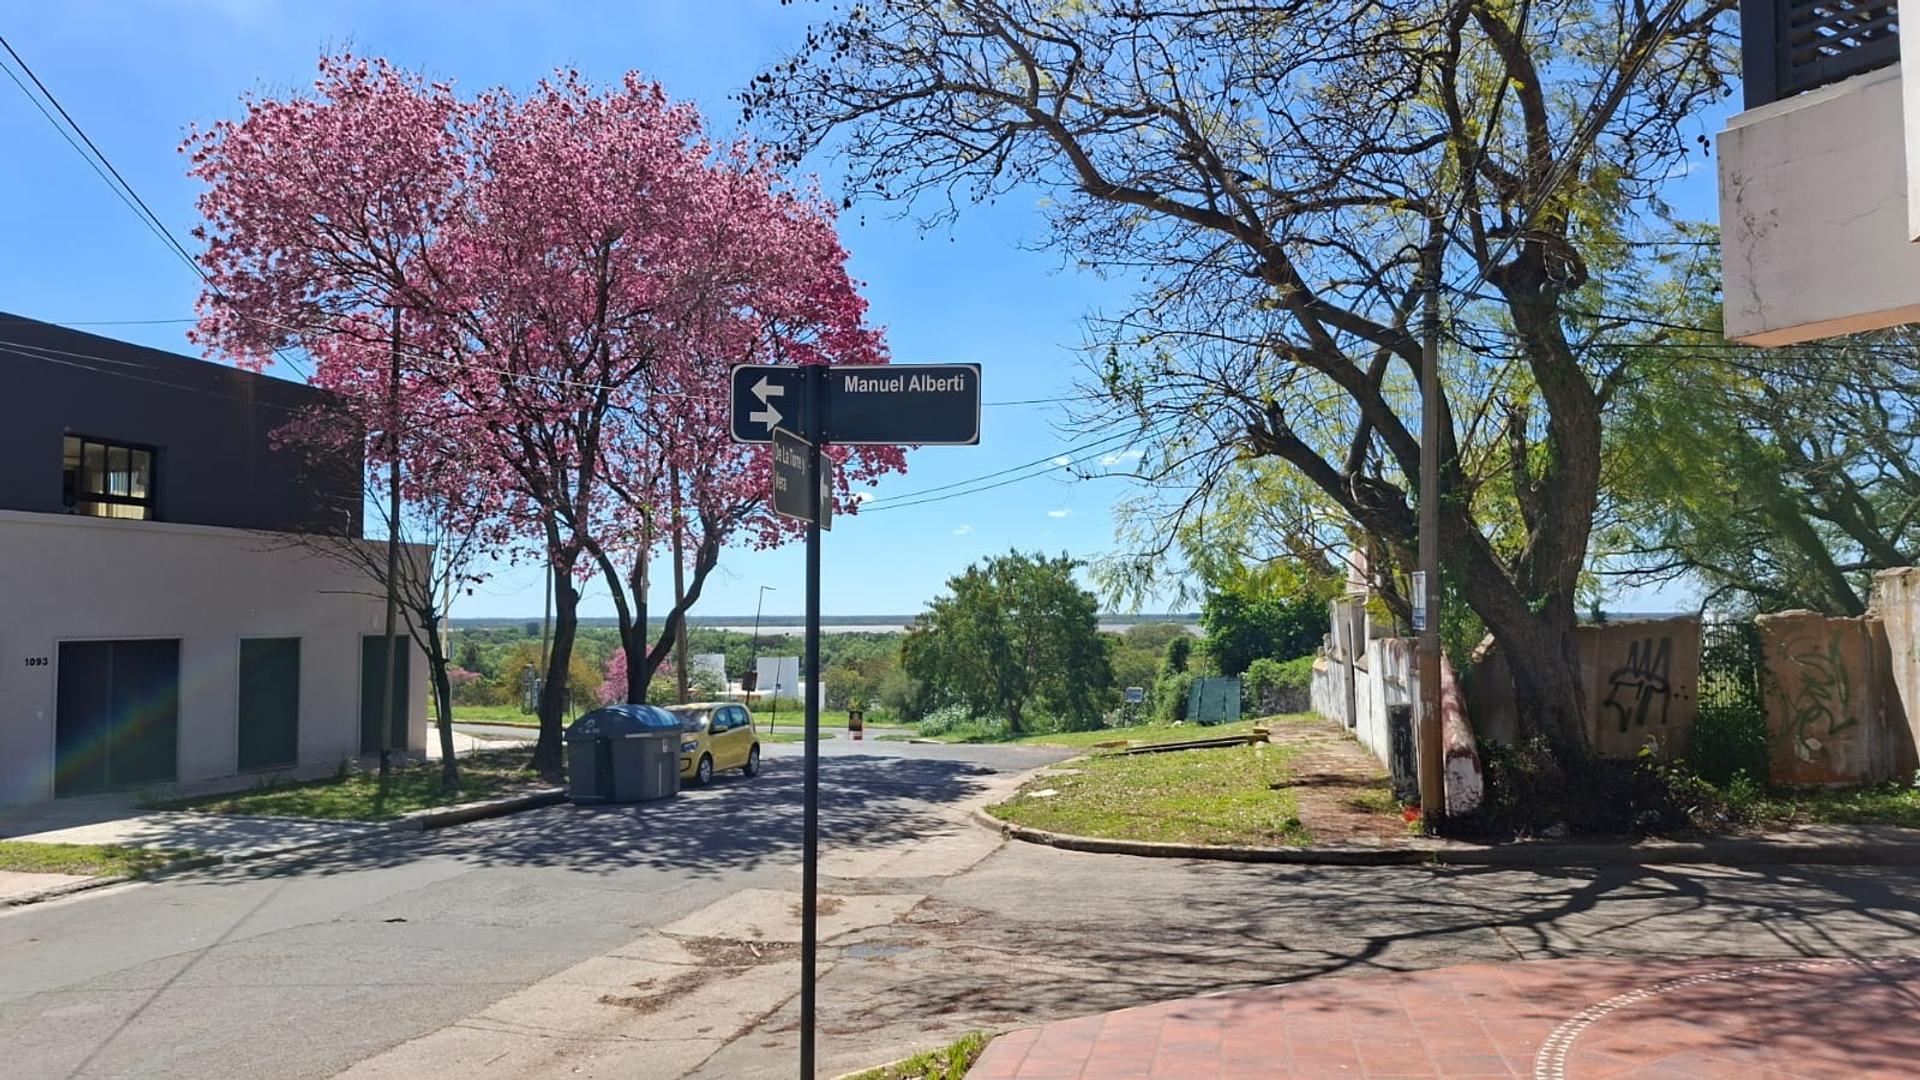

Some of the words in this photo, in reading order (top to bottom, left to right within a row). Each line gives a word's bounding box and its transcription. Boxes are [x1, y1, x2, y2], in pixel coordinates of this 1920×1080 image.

[844, 375, 904, 392] Manuel
[908, 374, 964, 392] Alberti
[782, 445, 790, 465] La
[25, 657, 48, 667] 1093
